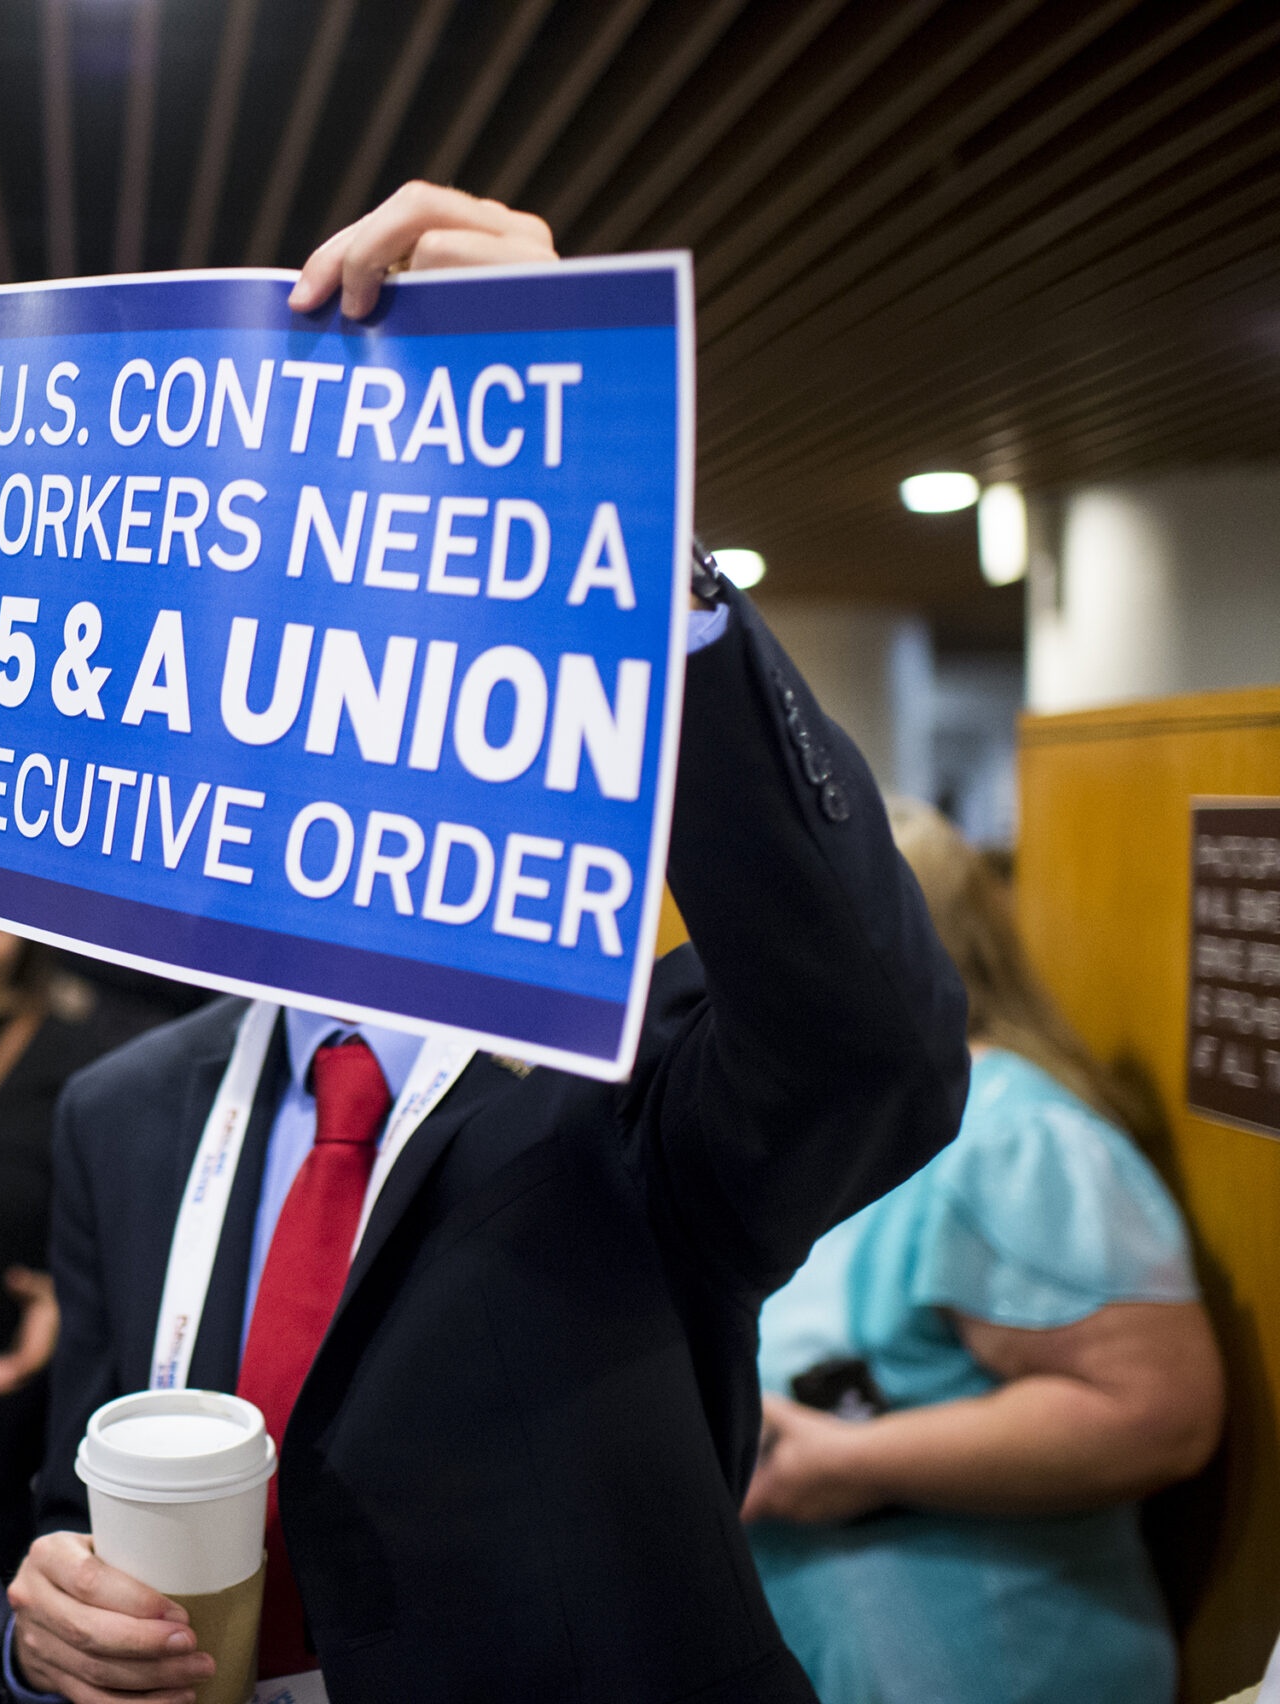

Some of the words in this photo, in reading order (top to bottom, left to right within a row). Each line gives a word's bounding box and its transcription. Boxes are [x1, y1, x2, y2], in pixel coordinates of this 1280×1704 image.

[109, 357, 583, 466] CONTRACT
[286, 485, 551, 600] NEED
[568, 503, 636, 608] A
[51, 601, 112, 720] &
[121, 609, 191, 733] A
[220, 616, 650, 800] UNION
[285, 801, 632, 956] ORDER
